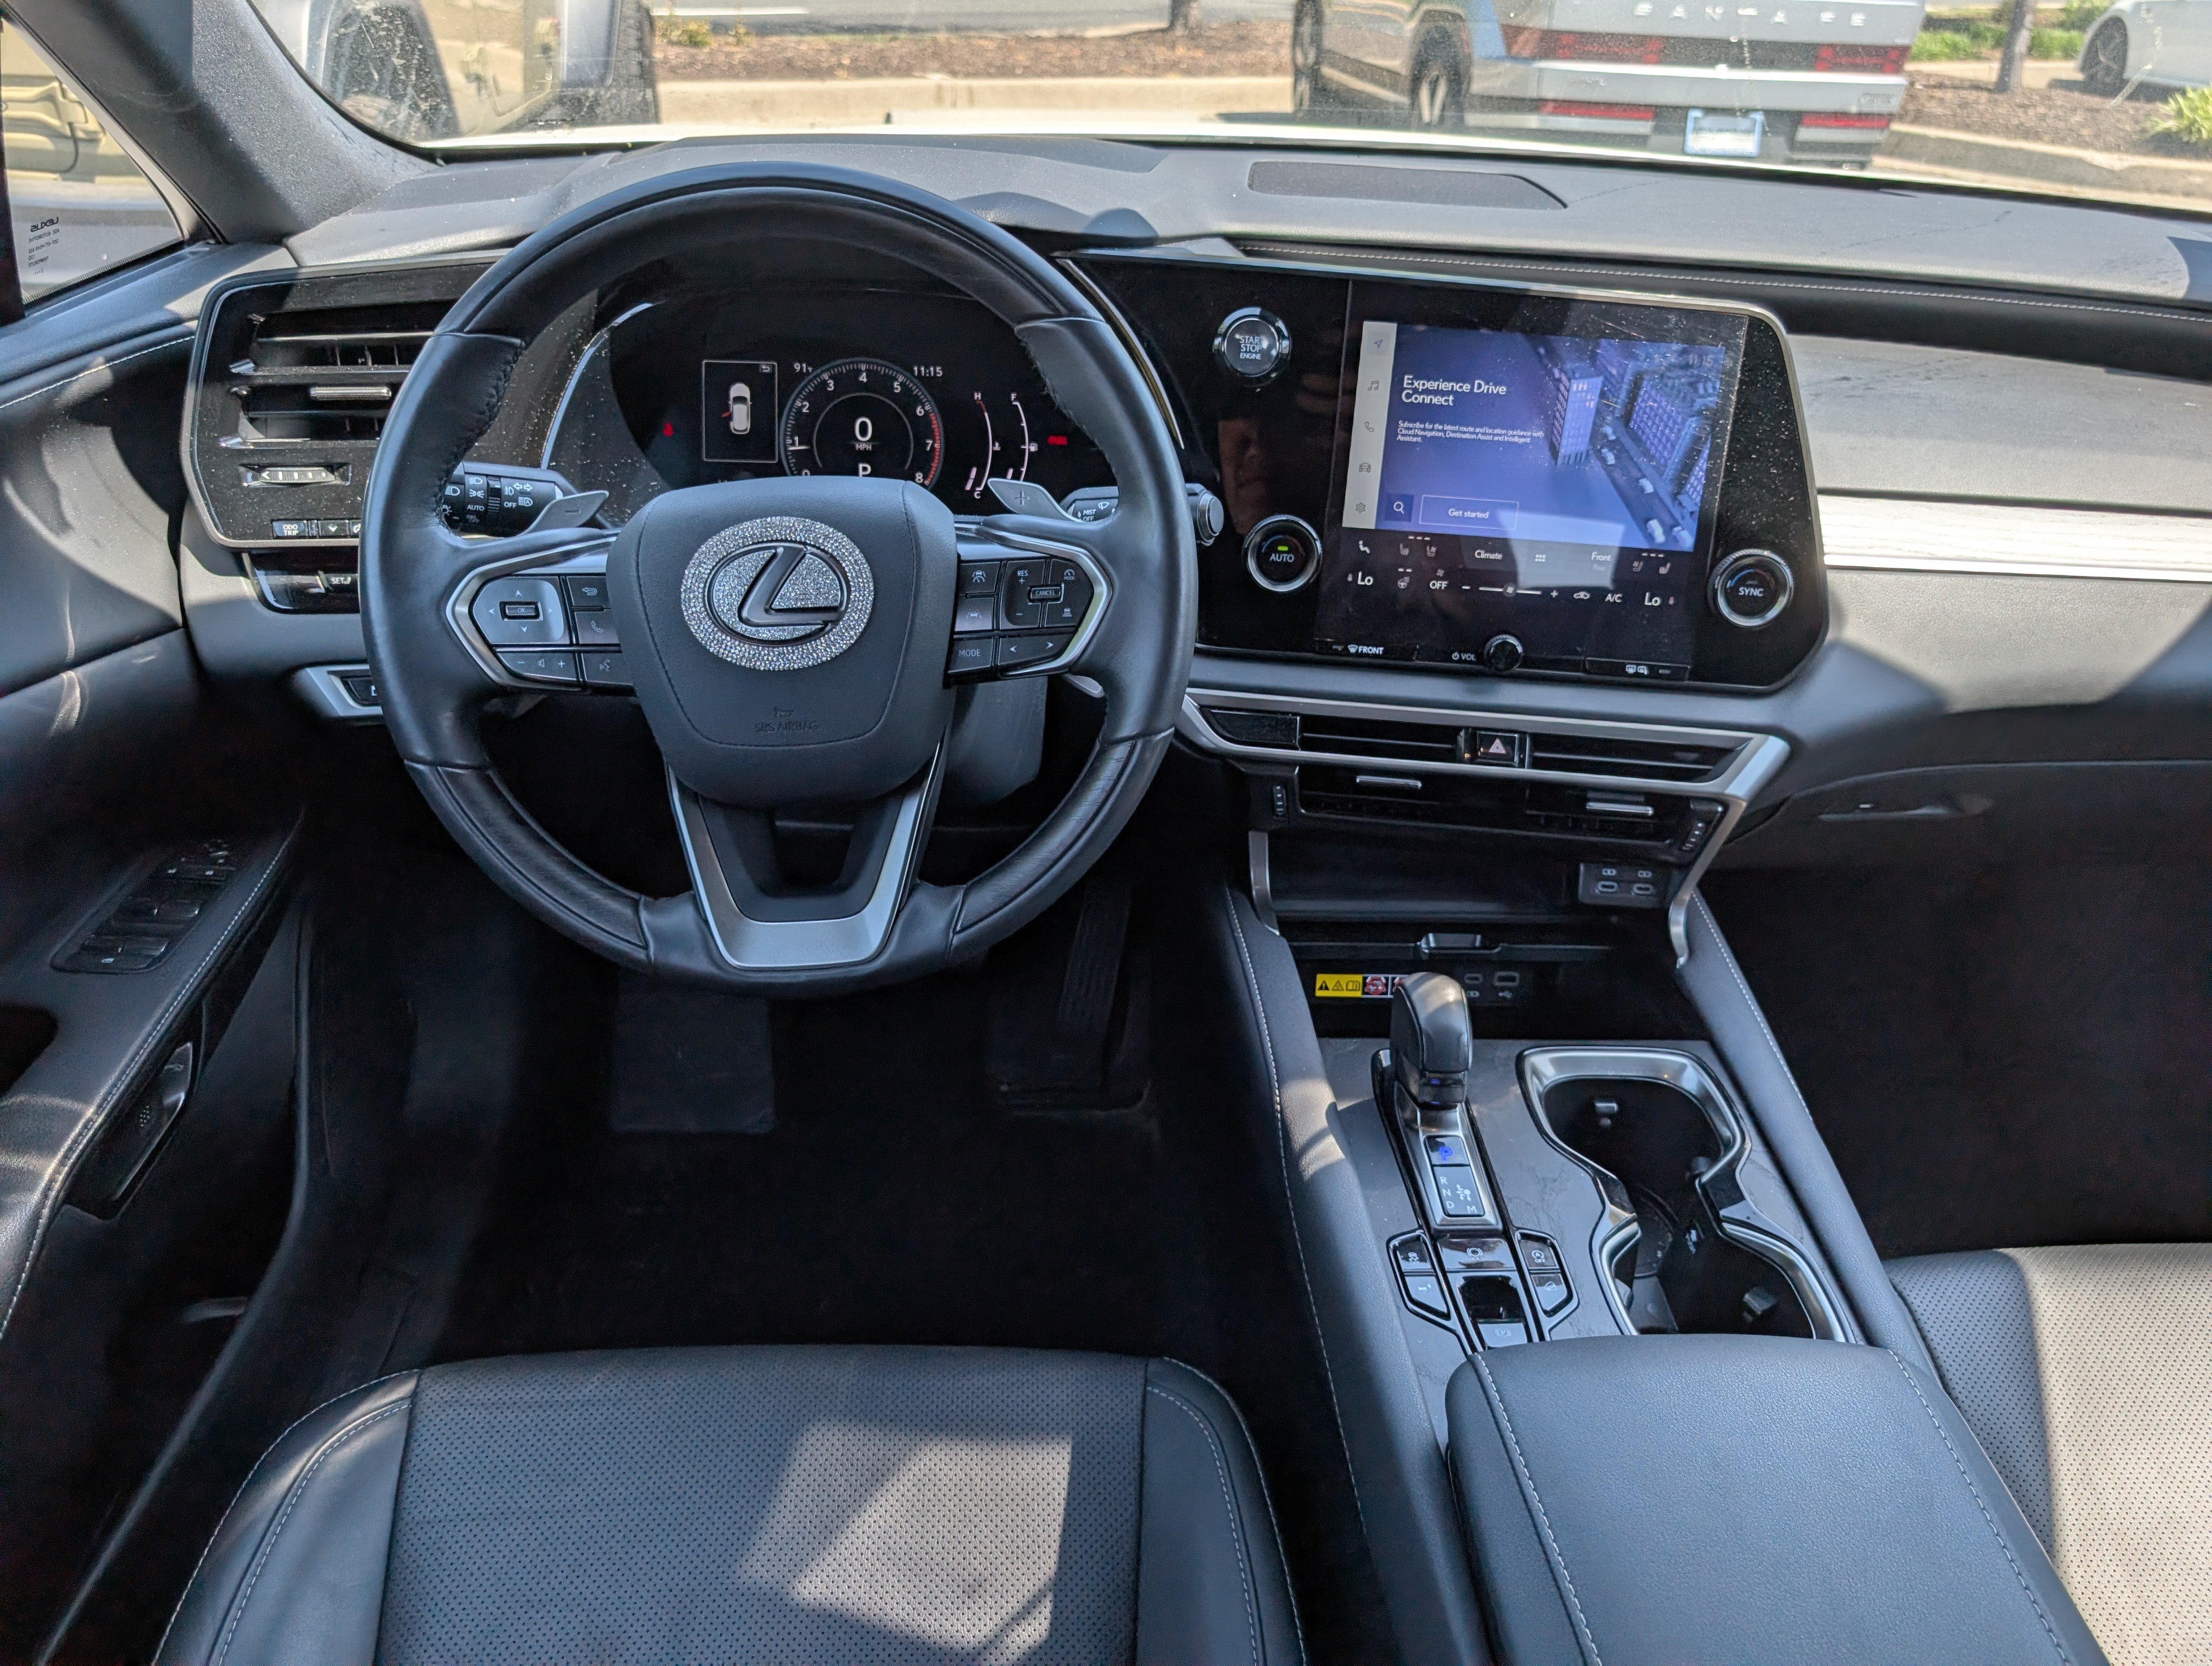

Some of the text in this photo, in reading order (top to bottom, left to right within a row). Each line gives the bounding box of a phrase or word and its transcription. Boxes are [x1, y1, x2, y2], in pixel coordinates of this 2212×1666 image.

[1240, 344, 1262, 353] STOP
[913, 366, 943, 377] 11:15
[859, 372, 867, 383] 4
[827, 380, 834, 390] 3
[893, 382, 901, 393] 5
[1403, 374, 1507, 395] Experience Drive
[974, 392, 981, 400] H
[1011, 393, 1017, 401] F
[1401, 389, 1454, 406] Connect
[802, 402, 810, 413] 2
[916, 406, 924, 416] 6
[854, 416, 872, 441] 0
[1398, 420, 1424, 428] Subscribe
[794, 436, 799, 446] 1
[1446, 431, 1476, 439] Destination
[1504, 435, 1531, 444] Intelligent
[925, 440, 933, 451] 7
[858, 463, 872, 477] P
[915, 472, 923, 483] 8
[1448, 508, 1489, 519] Get started
[1269, 553, 1295, 562] AUTO
[1475, 549, 1503, 560] Climate
[1591, 552, 1611, 561] Front
[330, 576, 345, 585] SET
[1358, 571, 1374, 586] Lo
[1430, 580, 1449, 590] OFF
[1738, 586, 1764, 597] SYNC
[1605, 593, 1623, 603] A/C
[1644, 591, 1662, 606] Lo
[959, 649, 981, 657] MODE
[1358, 645, 1384, 655] FRONT
[1461, 653, 1477, 661] VOL
[1439, 1146, 1454, 1162] P
[1440, 1176, 1448, 1184] R
[1442, 1188, 1451, 1196] N
[1445, 1201, 1455, 1209] D
[1467, 1205, 1477, 1214] M
